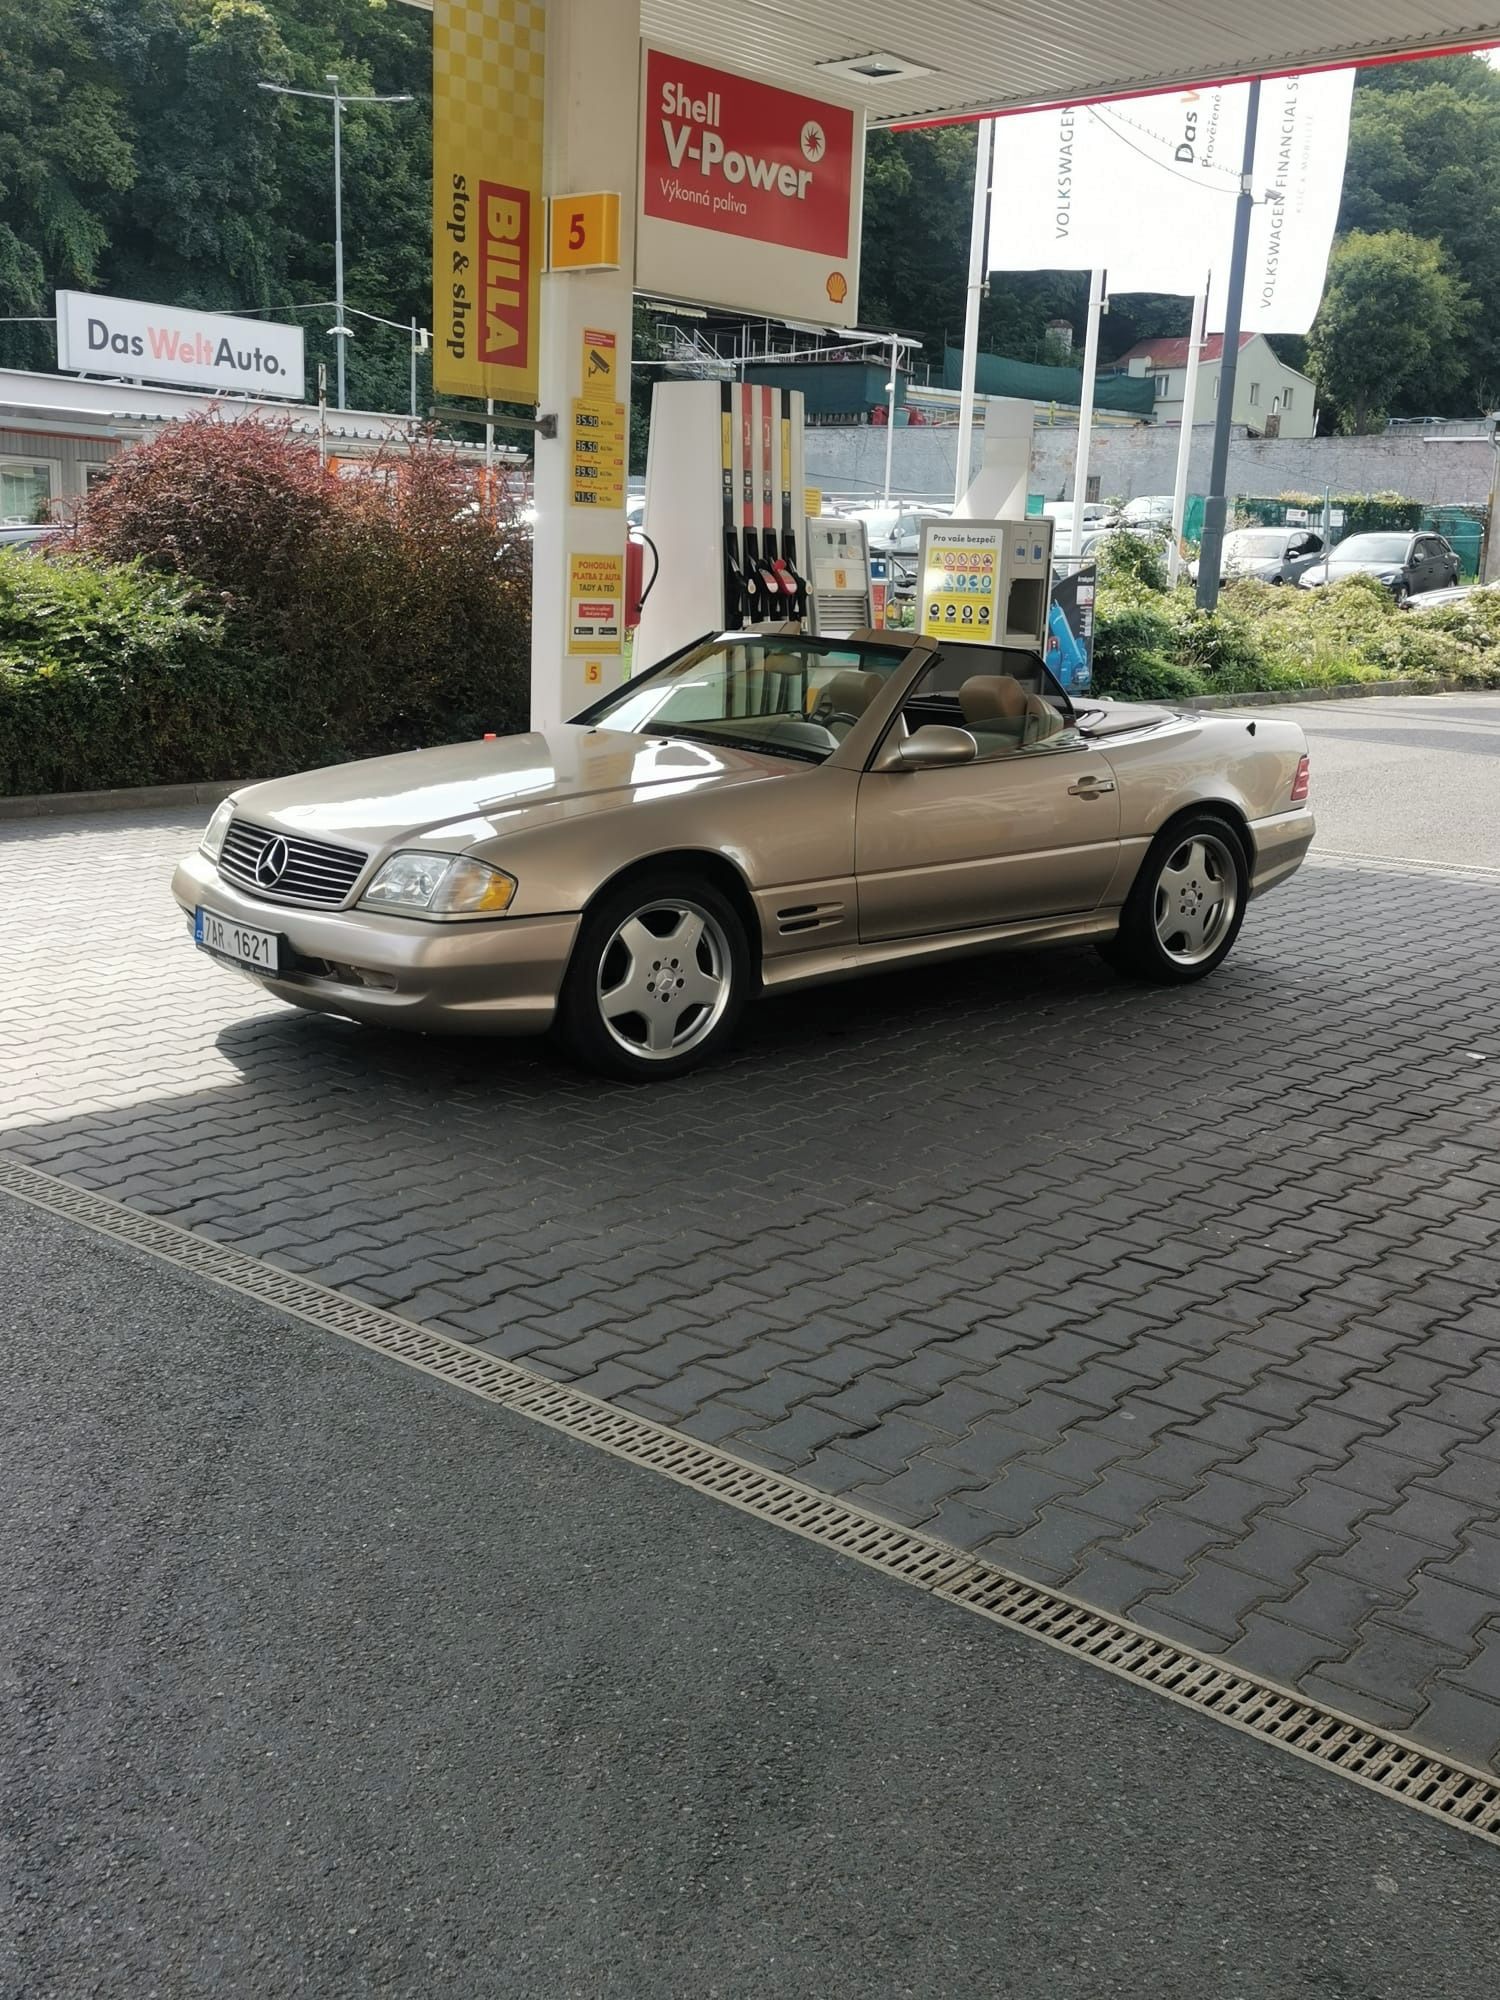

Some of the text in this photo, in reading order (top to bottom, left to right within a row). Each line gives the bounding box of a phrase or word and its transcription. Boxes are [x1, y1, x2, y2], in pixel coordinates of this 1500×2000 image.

[661, 81, 721, 127] Shell
[1174, 110, 1198, 164] Das
[661, 119, 813, 200] V-Power
[660, 177, 747, 215] Výkonná paliva
[1260, 192, 1286, 310] VOLKSWAGEN
[1275, 98, 1299, 188] FINANCIAL
[568, 213, 586, 250] 5
[446, 173, 472, 360] stop & shop
[485, 195, 522, 353] BILLA
[87, 318, 287, 376] Das WeltAuto.
[576, 414, 599, 427] 35.90
[576, 440, 598, 453] 36.50
[575, 465, 598, 478] 39.90
[933, 534, 946, 542] Pro
[948, 534, 965, 542] vaše
[573, 572, 621, 582] PLATBA Z AUTA
[578, 560, 616, 570] POHODLNÁ
[579, 582, 615, 593] TADY A TEĎ
[588, 665, 598, 681] 5
[205, 917, 224, 949] 7AR
[234, 929, 269, 964] 1621
